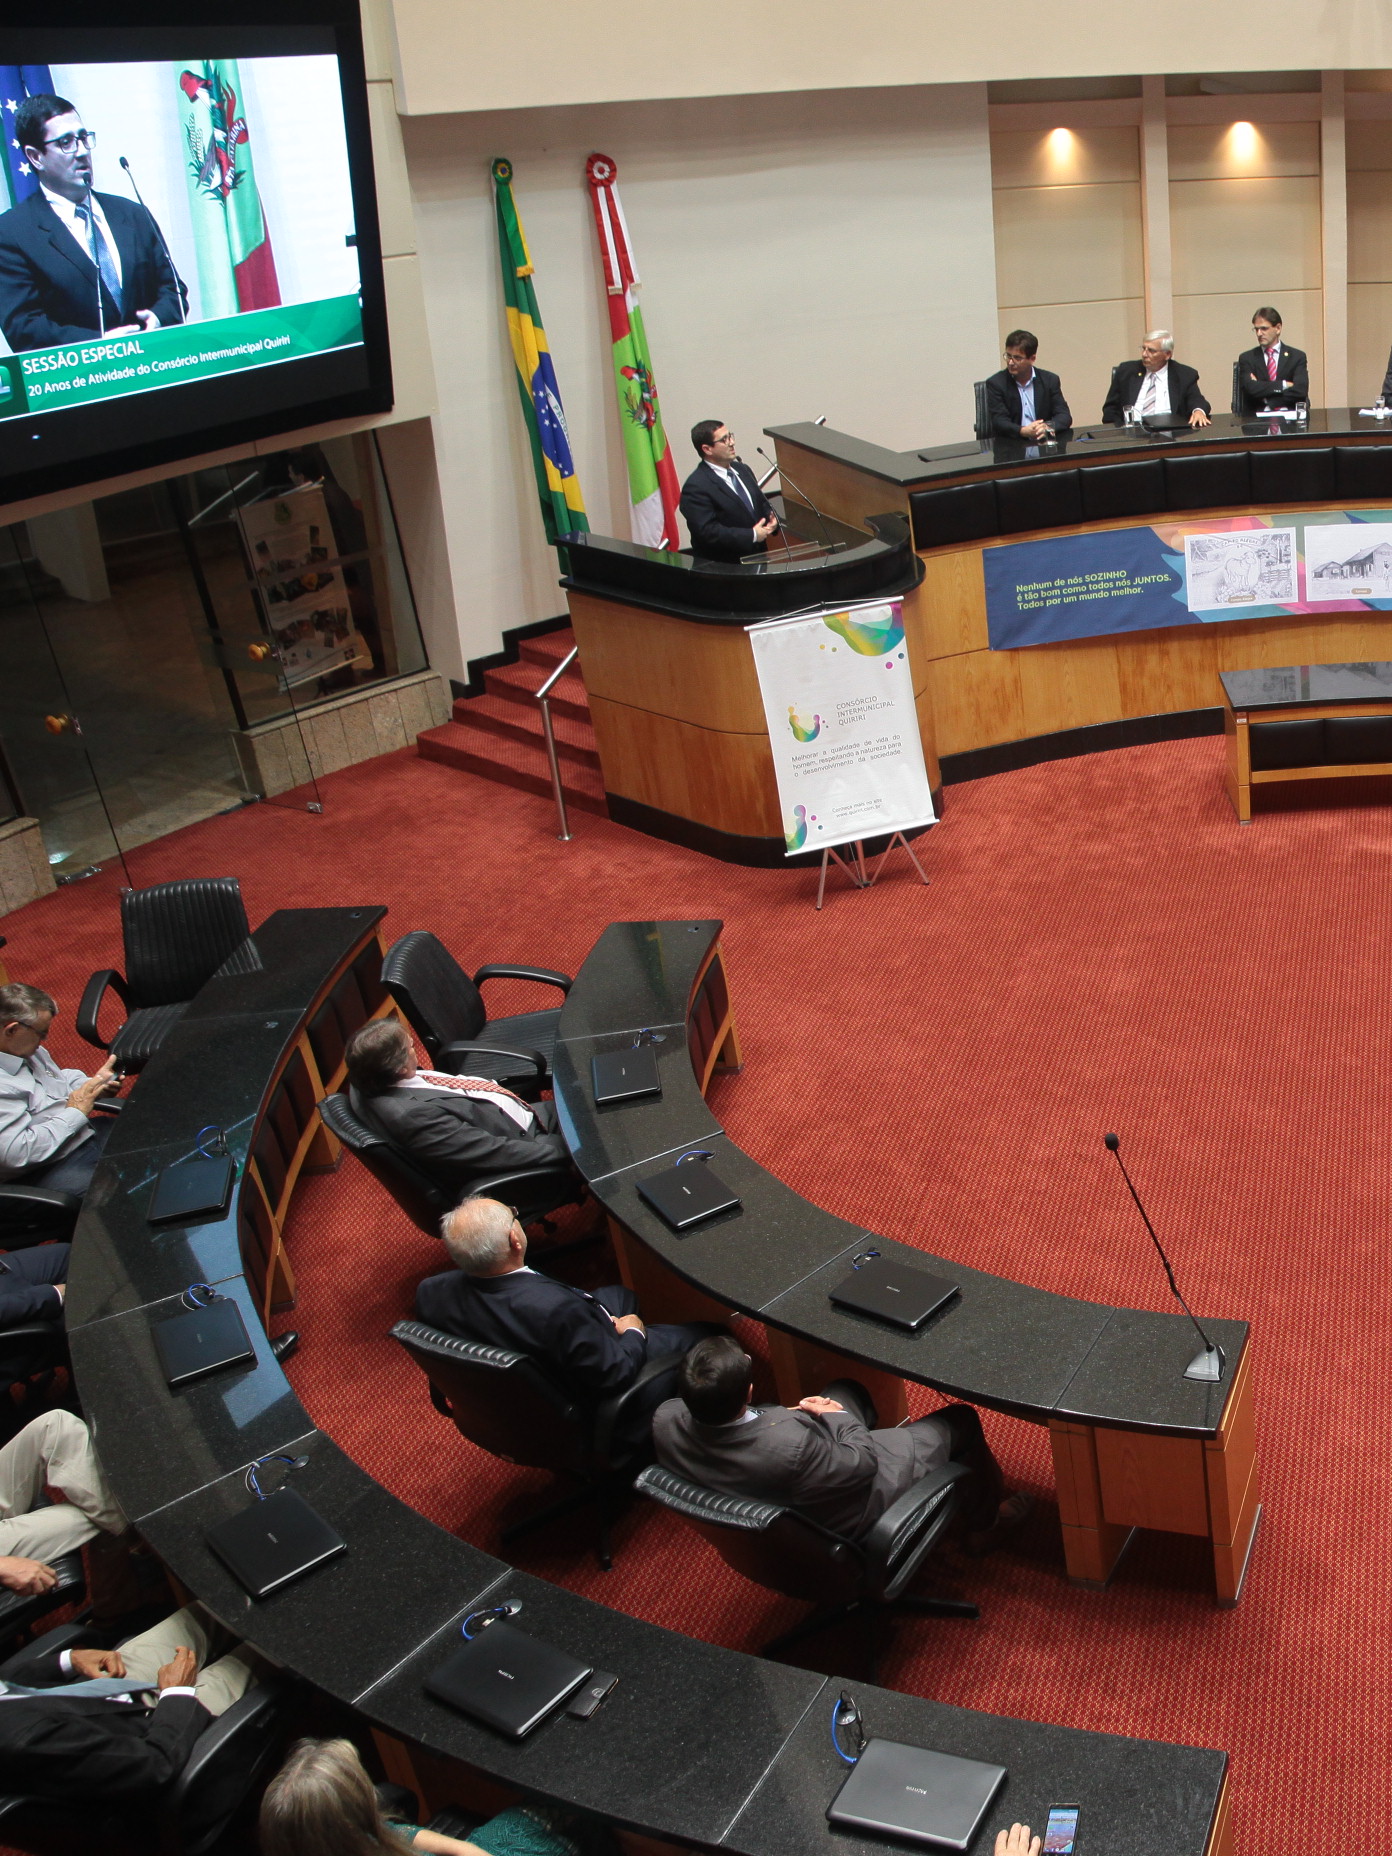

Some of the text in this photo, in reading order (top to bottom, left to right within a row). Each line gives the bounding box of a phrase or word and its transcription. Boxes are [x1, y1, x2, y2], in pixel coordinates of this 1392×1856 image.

[22, 340, 144, 375] SESSÃO ESPECIAL
[28, 384, 42, 396] 20
[44, 382, 71, 393] Anos
[73, 376, 86, 388] de
[88, 366, 135, 385] Atividade
[137, 364, 150, 375] do
[152, 354, 198, 372] Consórcio
[200, 340, 262, 362] Intermunicipal
[1016, 570, 1127, 592] Nenhum de nós SOZINHO
[1024, 592, 1038, 600] tão
[1040, 588, 1060, 597] bom
[1062, 586, 1086, 594] como
[1088, 581, 1114, 590] todos
[1116, 579, 1130, 587] nós
[1133, 574, 1172, 584] JUNTOS.
[1018, 587, 1144, 610] Todos por um mundo melhor.
[836, 696, 878, 710] CONSÓRCIO
[837, 700, 895, 718] INTERMUNICIPAL
[838, 714, 866, 726] QUIRIRI
[792, 752, 818, 762] Melhorar
[831, 742, 860, 754] qualidade
[860, 744, 886, 754] natureza
[888, 742, 902, 750] para
[803, 760, 854, 775] desenvolvimento
